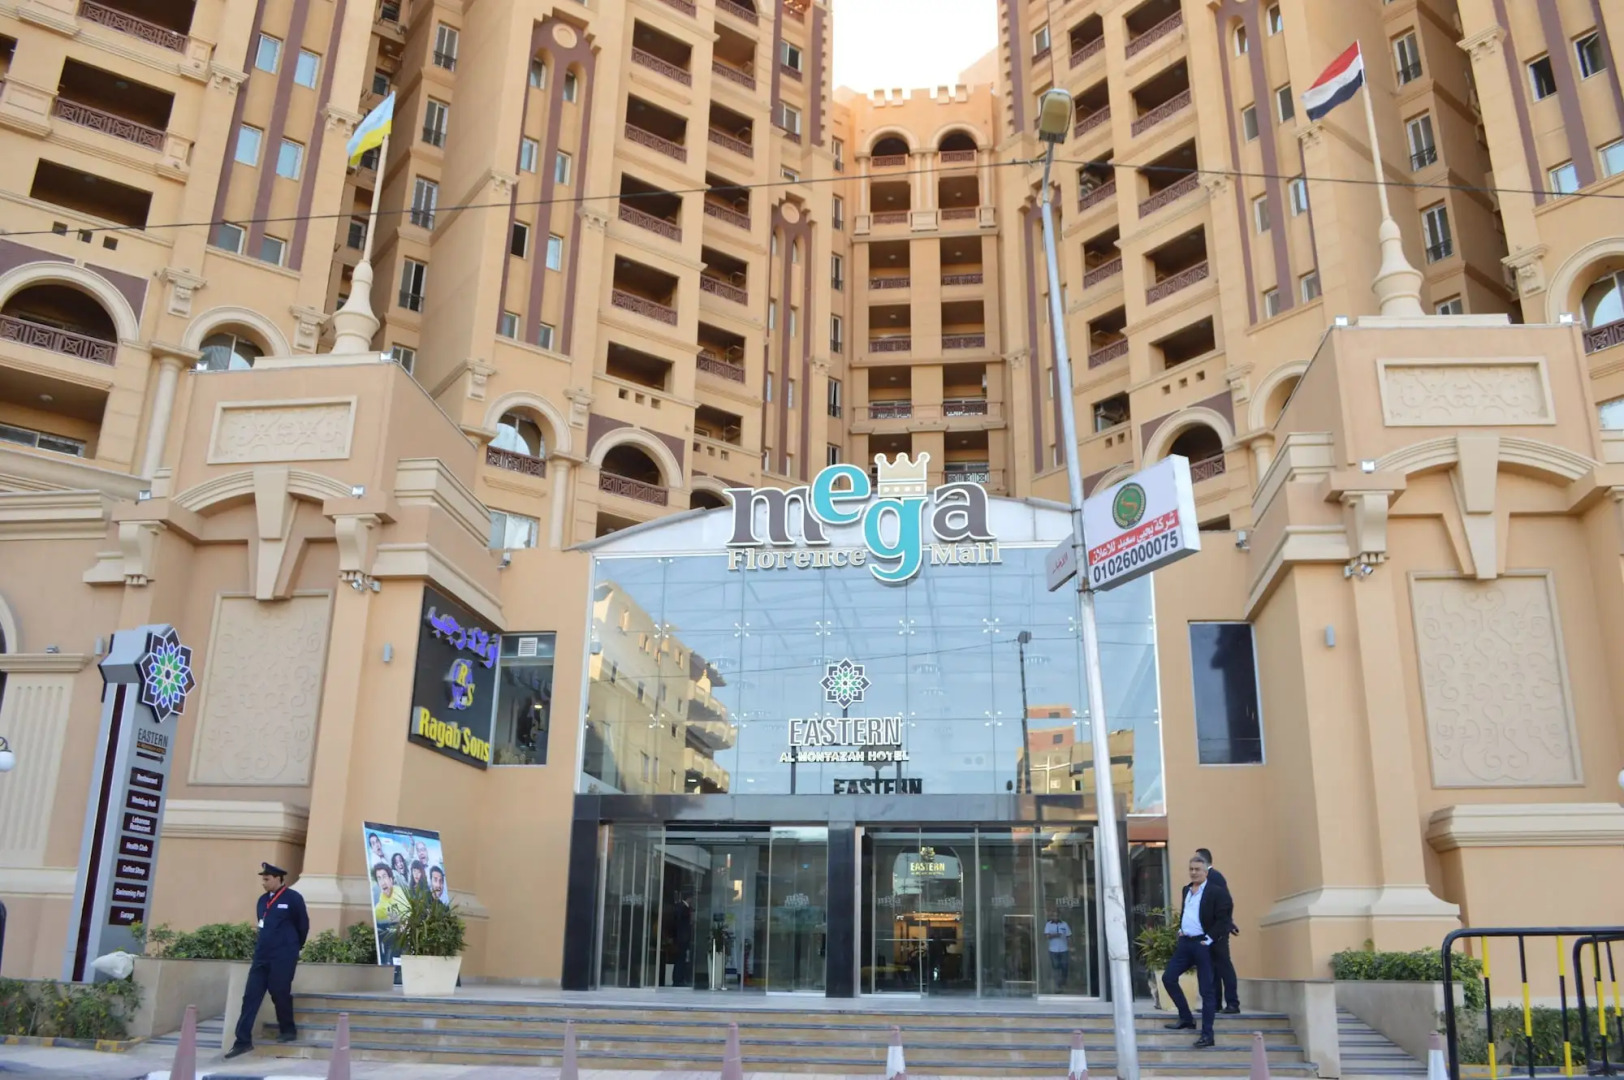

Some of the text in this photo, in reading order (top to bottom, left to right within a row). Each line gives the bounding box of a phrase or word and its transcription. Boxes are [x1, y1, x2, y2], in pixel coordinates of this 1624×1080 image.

[724, 463, 998, 583] mega
[726, 543, 1003, 571] Florence Mall
[1093, 530, 1179, 583] 01026000075
[137, 728, 169, 747] EASTERN
[419, 707, 490, 762] Ragab Sons
[789, 717, 902, 746] EASTERN
[780, 751, 795, 763] AL
[868, 750, 910, 763] HOTEL
[910, 862, 945, 872] EASTERN
